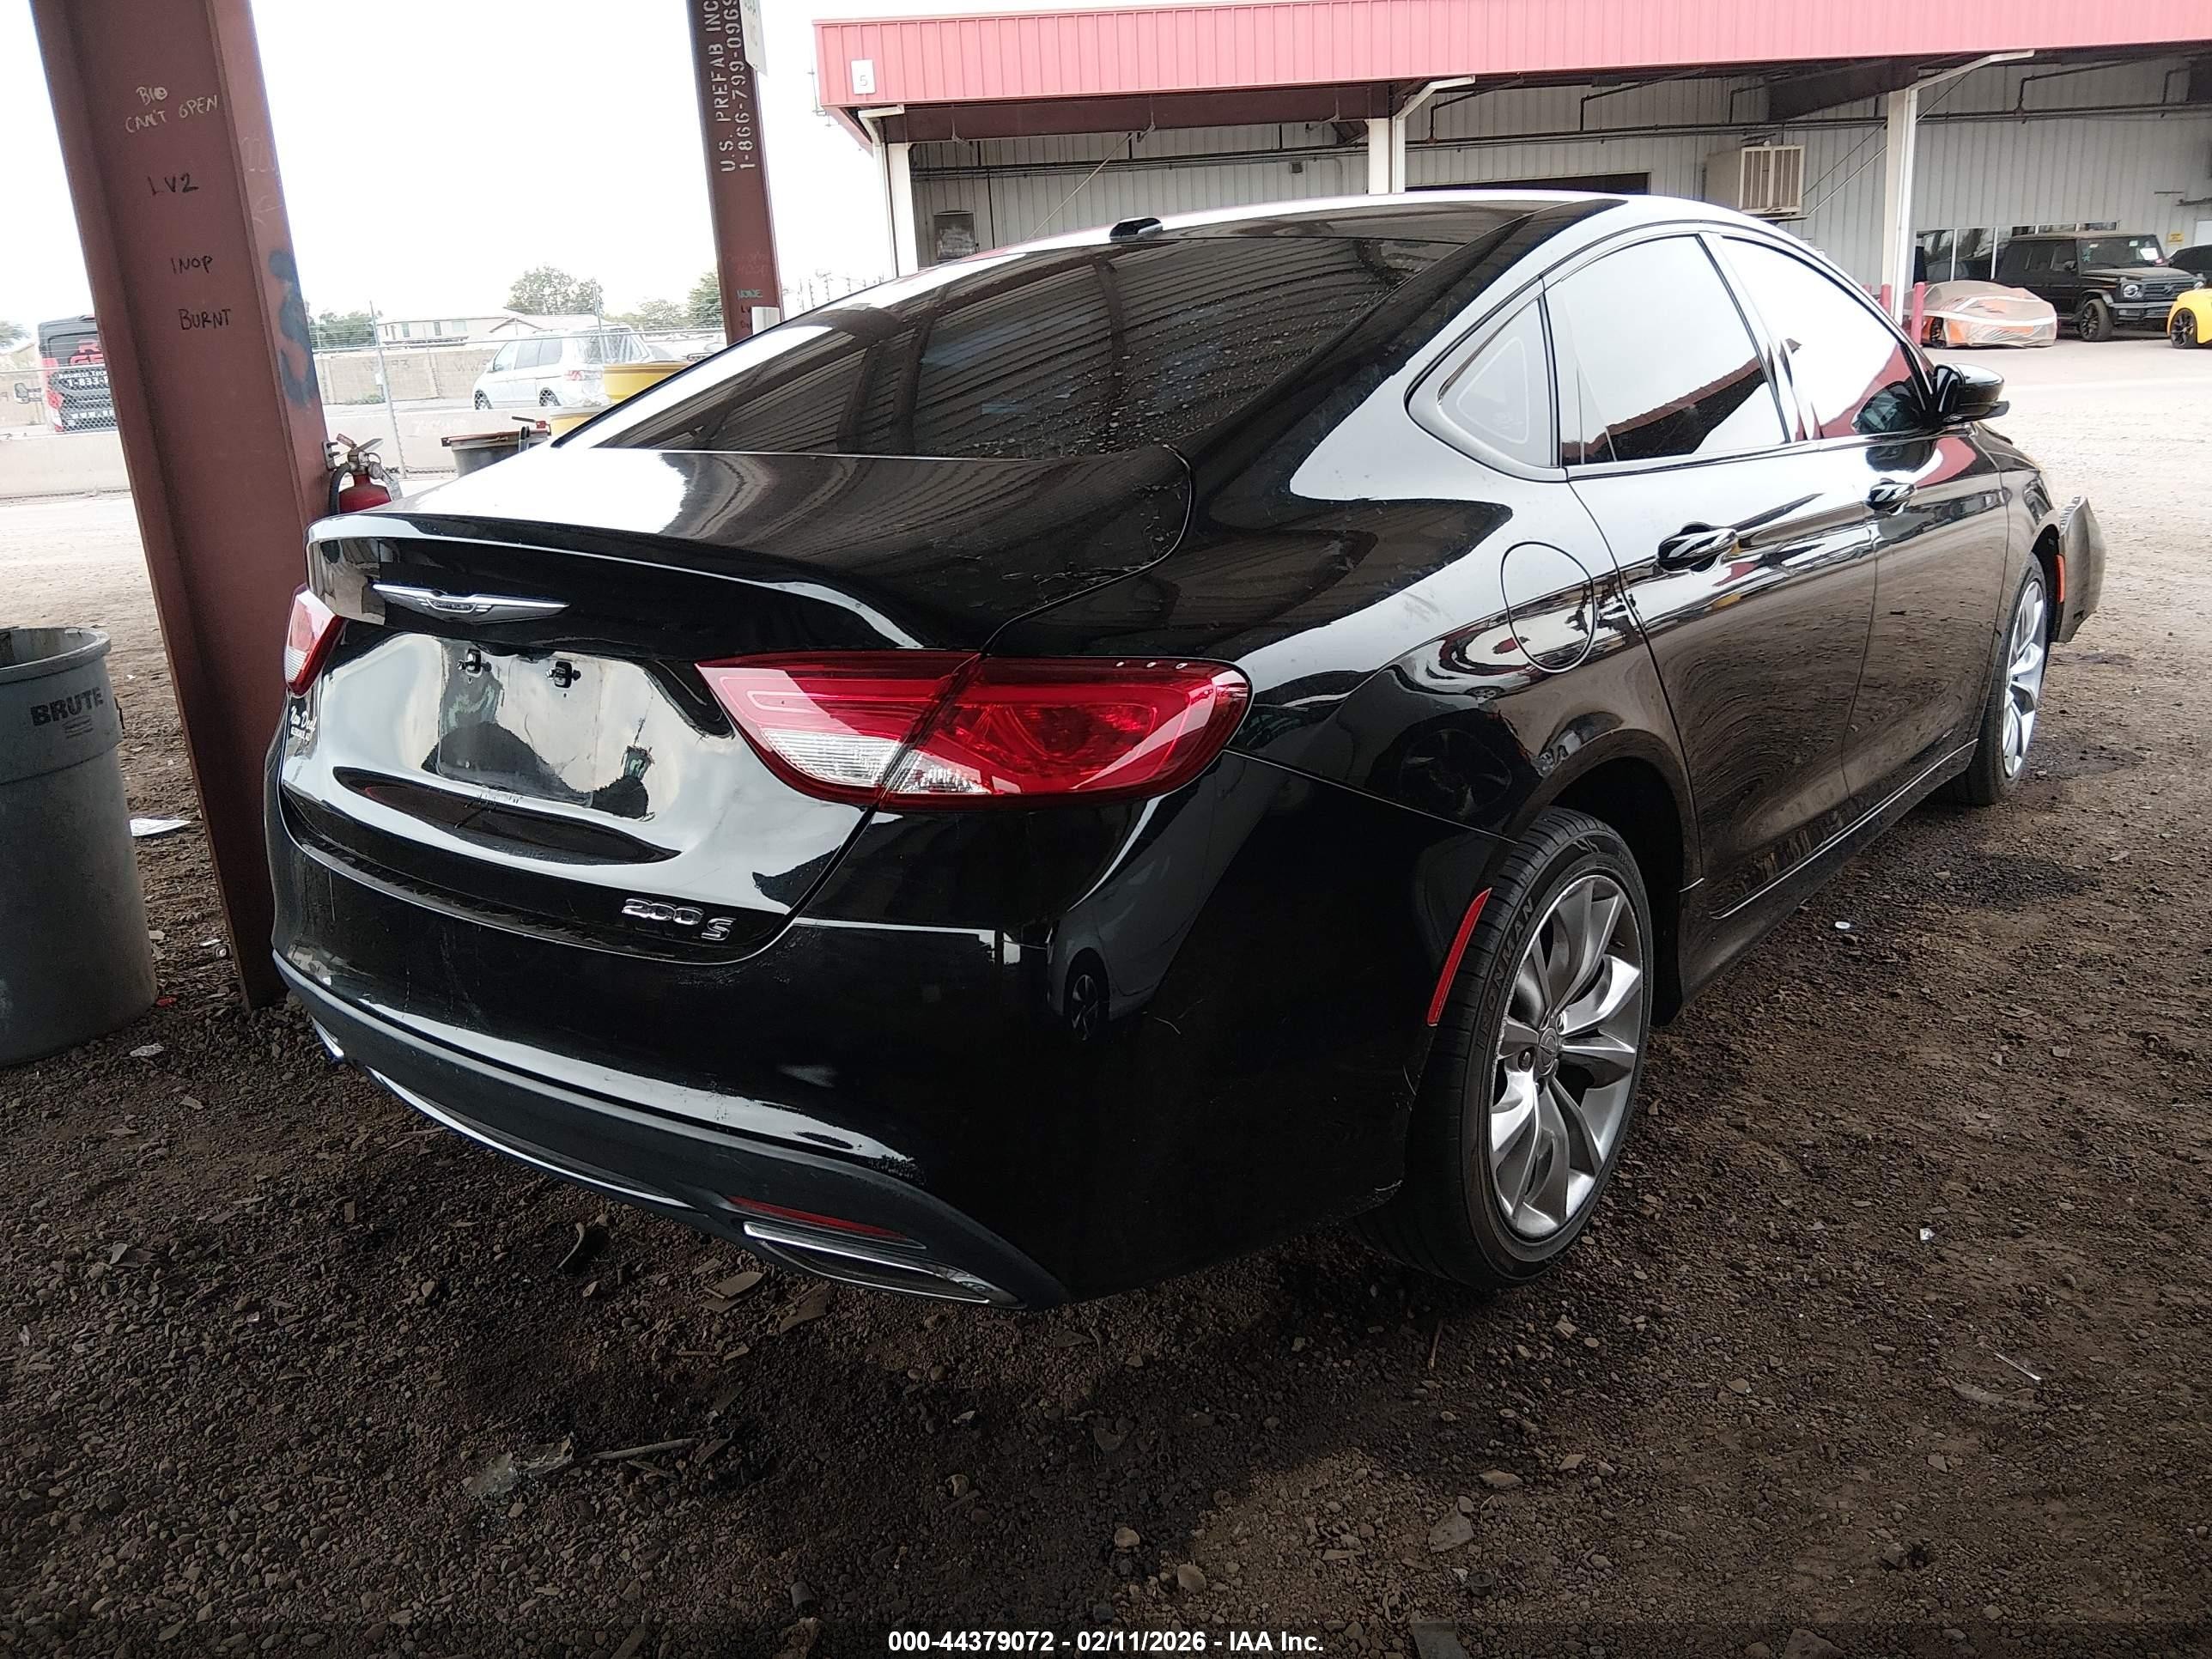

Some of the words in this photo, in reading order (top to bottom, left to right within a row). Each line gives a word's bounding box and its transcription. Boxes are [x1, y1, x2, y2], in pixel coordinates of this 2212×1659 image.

[708, 44, 732, 122] PREFAB
[860, 75, 868, 87] 5
[125, 109, 167, 133] CAN'T
[719, 134, 736, 173] U.S.
[171, 255, 213, 274] INOP
[179, 308, 231, 331] BURNT
[29, 688, 105, 726] BRUTE
[622, 898, 705, 926] 200
[700, 916, 738, 941] S
